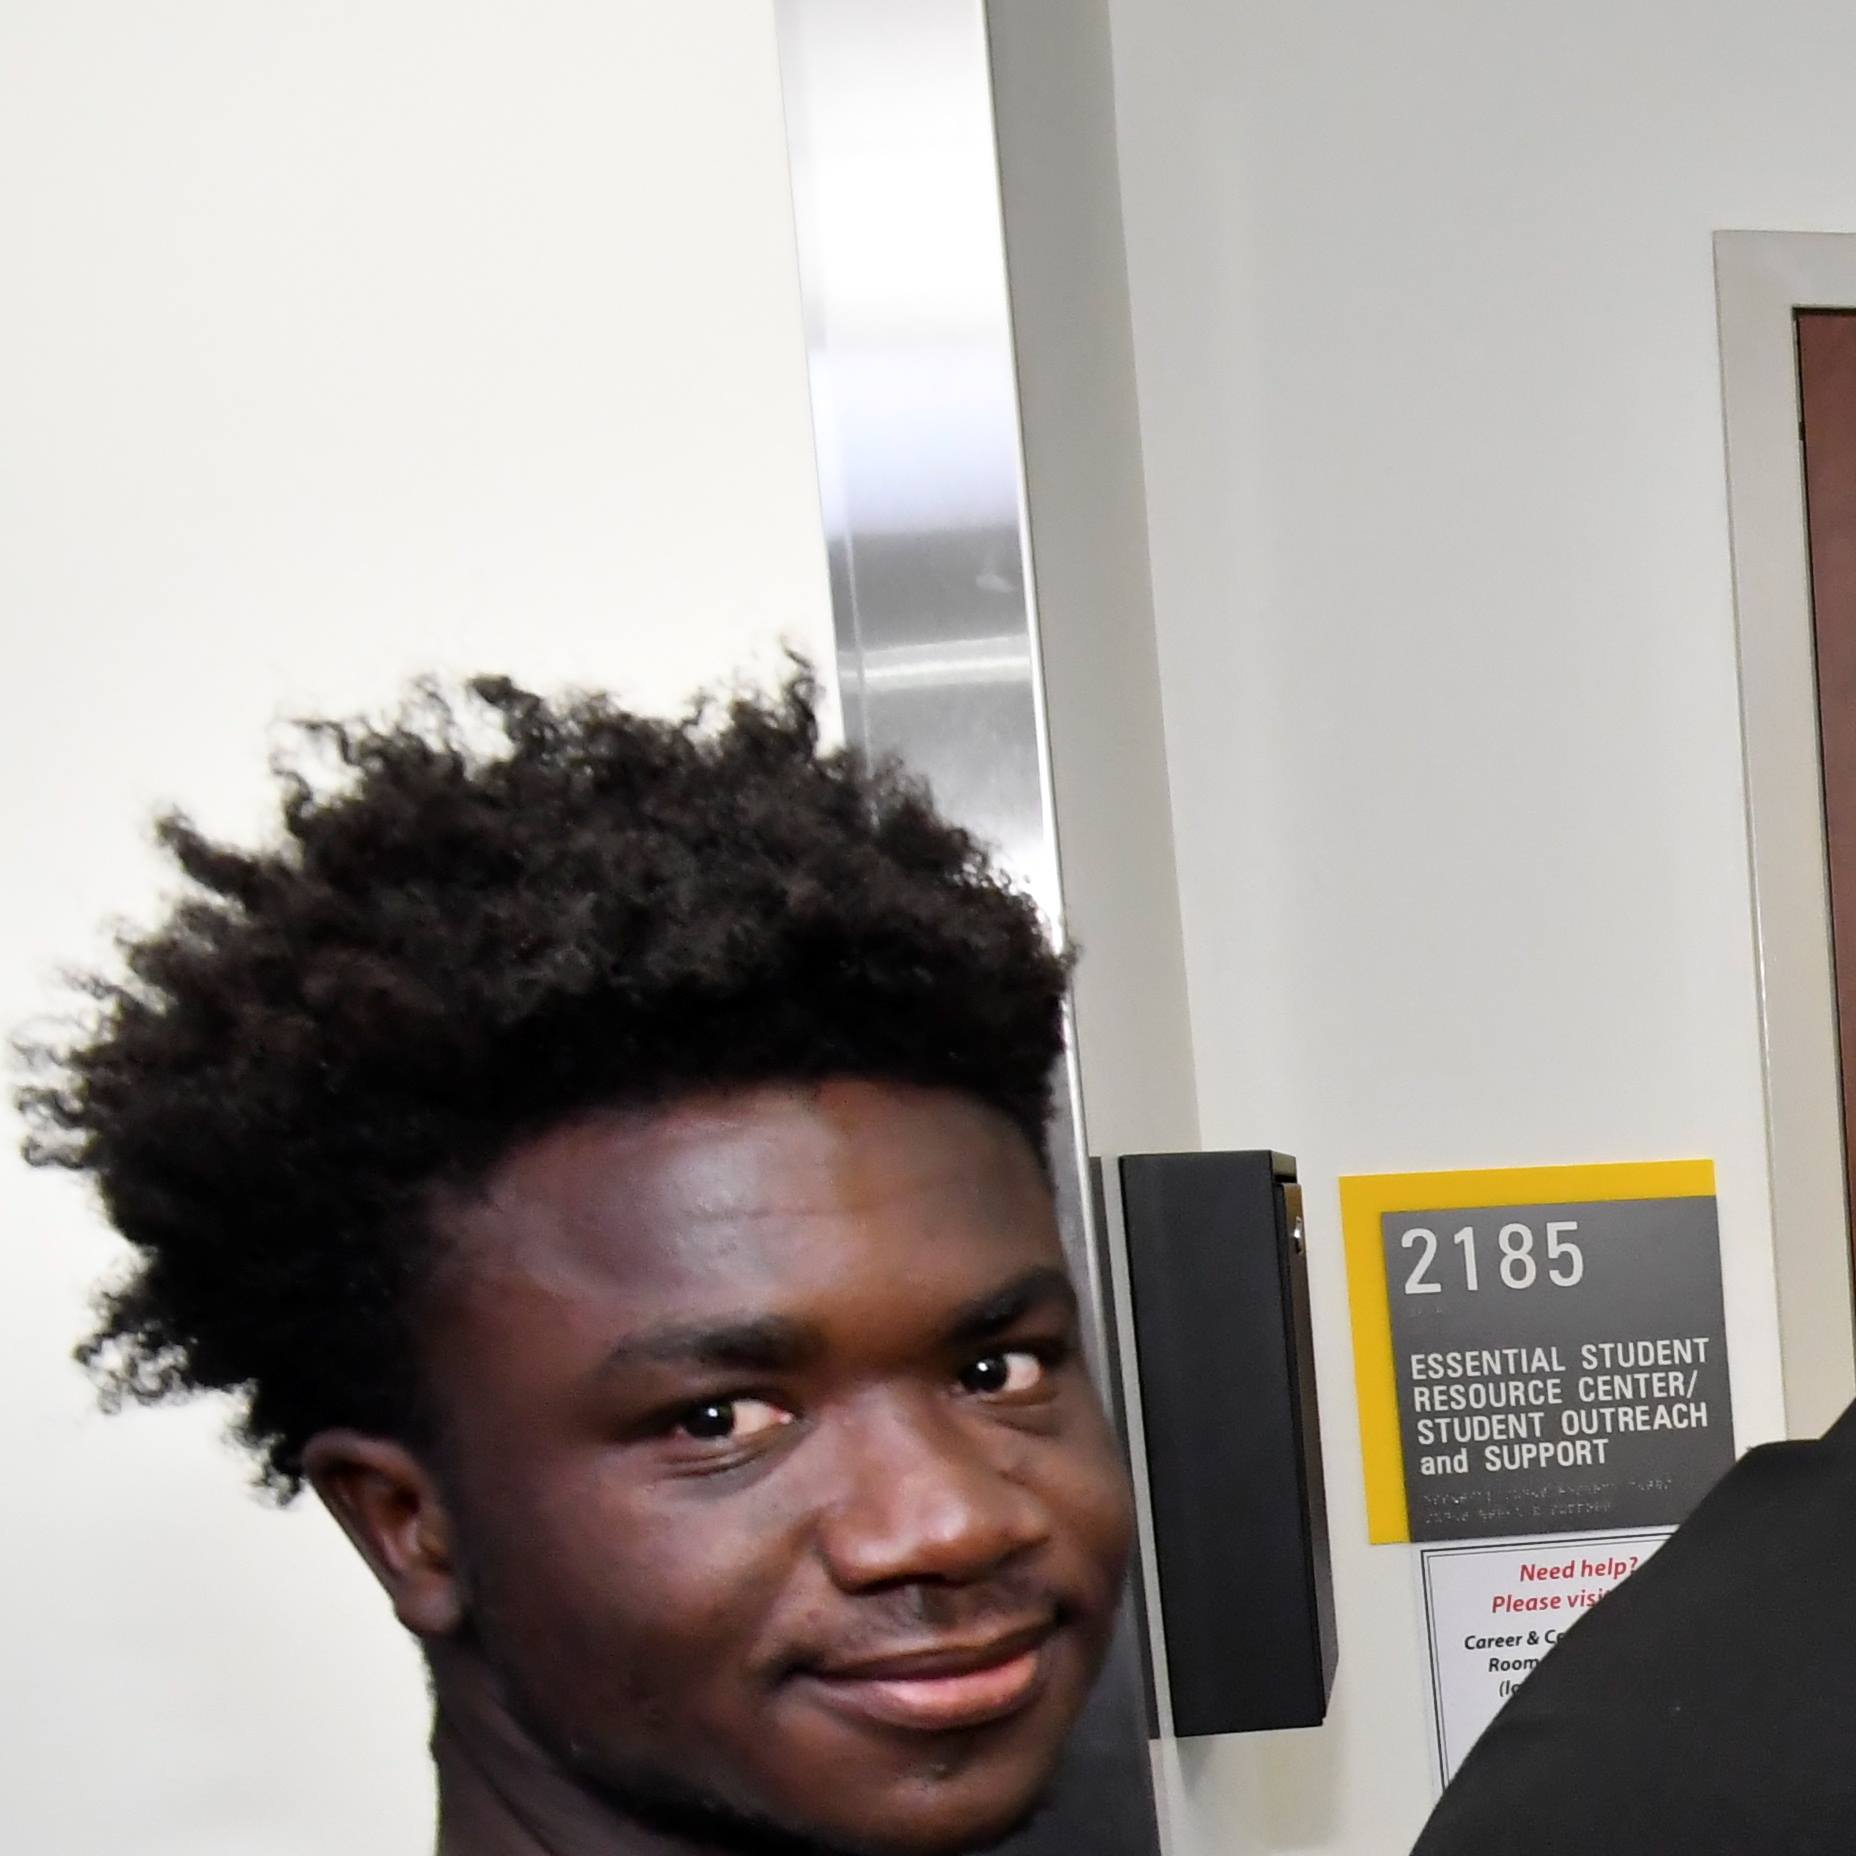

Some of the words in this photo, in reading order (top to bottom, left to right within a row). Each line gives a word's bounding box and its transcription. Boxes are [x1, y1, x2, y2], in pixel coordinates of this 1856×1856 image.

[1401, 1221, 1584, 1294] 2185
[1411, 1347, 1566, 1380] ESSENTIAL
[1581, 1337, 1710, 1370] STUDENT
[1413, 1378, 1563, 1412] RESOURCE
[1578, 1369, 1698, 1402] CENTER/
[1416, 1412, 1545, 1445] STUDENT
[1561, 1402, 1708, 1436] OUTREACH
[1420, 1448, 1469, 1475] and
[1484, 1438, 1609, 1472] SUPPORT
[1520, 1560, 1575, 1582] Need
[1580, 1556, 1639, 1579] help?
[1492, 1592, 1562, 1614] Please
[1464, 1632, 1523, 1651] Career
[1526, 1629, 1540, 1646] &
[1488, 1656, 1540, 1673] Room
